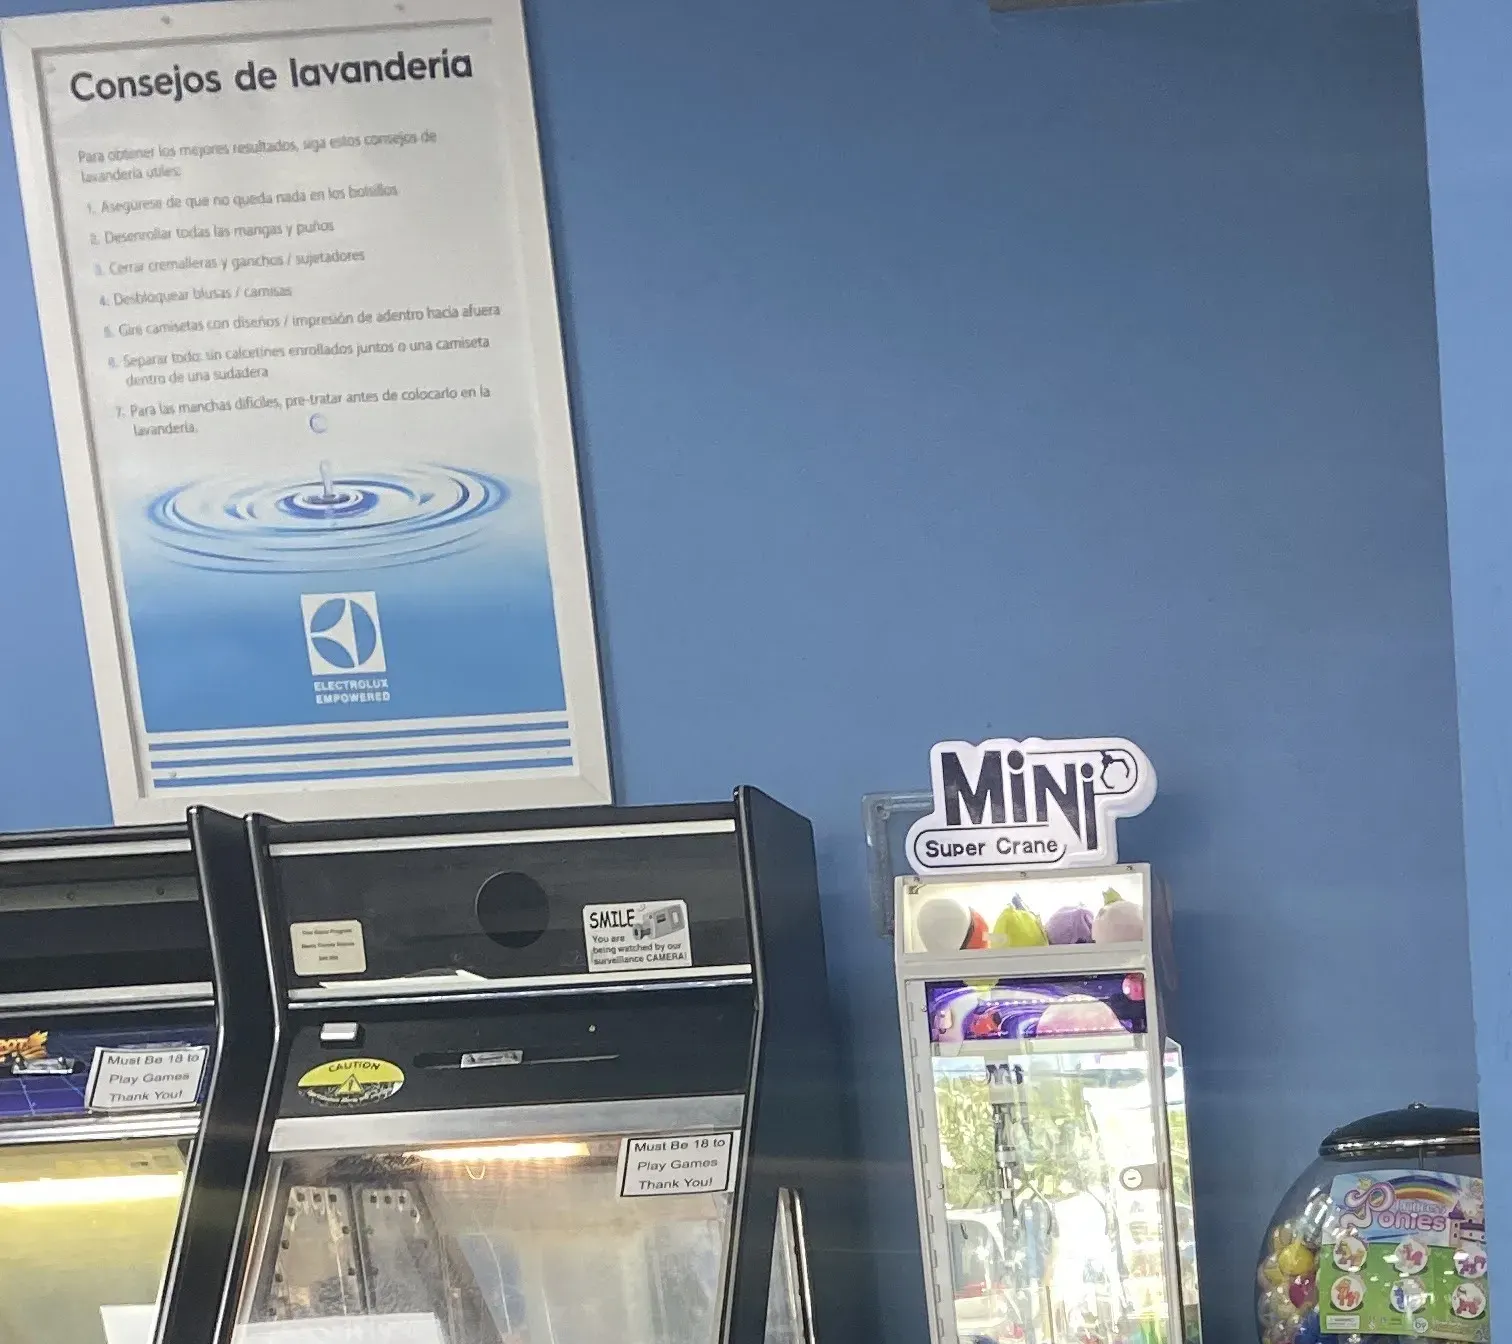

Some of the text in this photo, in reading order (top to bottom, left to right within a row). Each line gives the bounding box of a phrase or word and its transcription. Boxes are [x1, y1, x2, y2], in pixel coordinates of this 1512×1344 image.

[70, 64, 222, 102] Consejos
[234, 60, 277, 92] de
[78, 150, 105, 163] Para
[158, 144, 176, 158] los
[179, 143, 229, 160] mejores
[364, 131, 417, 147] consejos
[421, 128, 437, 143] de
[166, 193, 181, 208] de
[185, 196, 209, 209] que
[213, 195, 229, 206] no
[233, 190, 273, 208] queda
[276, 189, 306, 203] nada
[310, 190, 325, 201] en
[328, 187, 345, 200] los
[348, 182, 398, 199] bolsillos
[105, 226, 172, 245] Desenrollar
[176, 224, 210, 239] todas
[213, 223, 230, 238] las
[233, 222, 283, 240] mangas
[285, 223, 293, 238] y
[109, 261, 144, 276] Cerrar
[148, 255, 217, 273] cremalleras
[220, 256, 228, 271] y
[231, 253, 285, 272] ganchos
[295, 249, 366, 268] sujetadores
[114, 289, 189, 307] Desbloquear
[193, 286, 232, 300] blusas
[244, 284, 292, 299] camisas
[146, 318, 204, 336] camisetas
[207, 318, 230, 331] con
[357, 310, 373, 324] de
[376, 307, 424, 324] adentro
[426, 305, 459, 320] hacia
[462, 303, 501, 319] afuera
[123, 352, 168, 370] Separar
[205, 349, 222, 362] sin
[225, 344, 285, 362] calcetines
[288, 341, 353, 357] enrollados
[356, 339, 394, 358] juntos
[397, 341, 406, 353] o
[409, 338, 433, 352] una
[436, 335, 490, 352] camiseta
[126, 365, 269, 388] dentro de una sudadera
[130, 403, 156, 418] Para
[159, 400, 176, 415] las
[178, 398, 232, 415] manchas
[285, 392, 342, 410] pre-tratar
[346, 391, 379, 405] antes
[382, 387, 398, 402] de
[401, 386, 458, 402] colocarlo
[460, 386, 477, 399] en
[479, 383, 491, 399] la
[313, 678, 389, 692] ELECTROLUX
[315, 691, 391, 704] EMPOWERED
[925, 837, 1058, 858] Super Crane
[589, 907, 635, 929] SMILE
[592, 935, 625, 944] You are
[592, 942, 682, 955] being watched by our
[593, 951, 688, 966] surveillance CAMERA!
[107, 1053, 200, 1066] Must Be 18 to
[328, 1060, 381, 1073] CAUTION
[109, 1071, 190, 1086] Play Games
[109, 1089, 183, 1103] Thank You!
[634, 1138, 726, 1152] Must Be 18 to
[637, 1159, 718, 1173] Play Games
[638, 1177, 713, 1190] Thank You!
